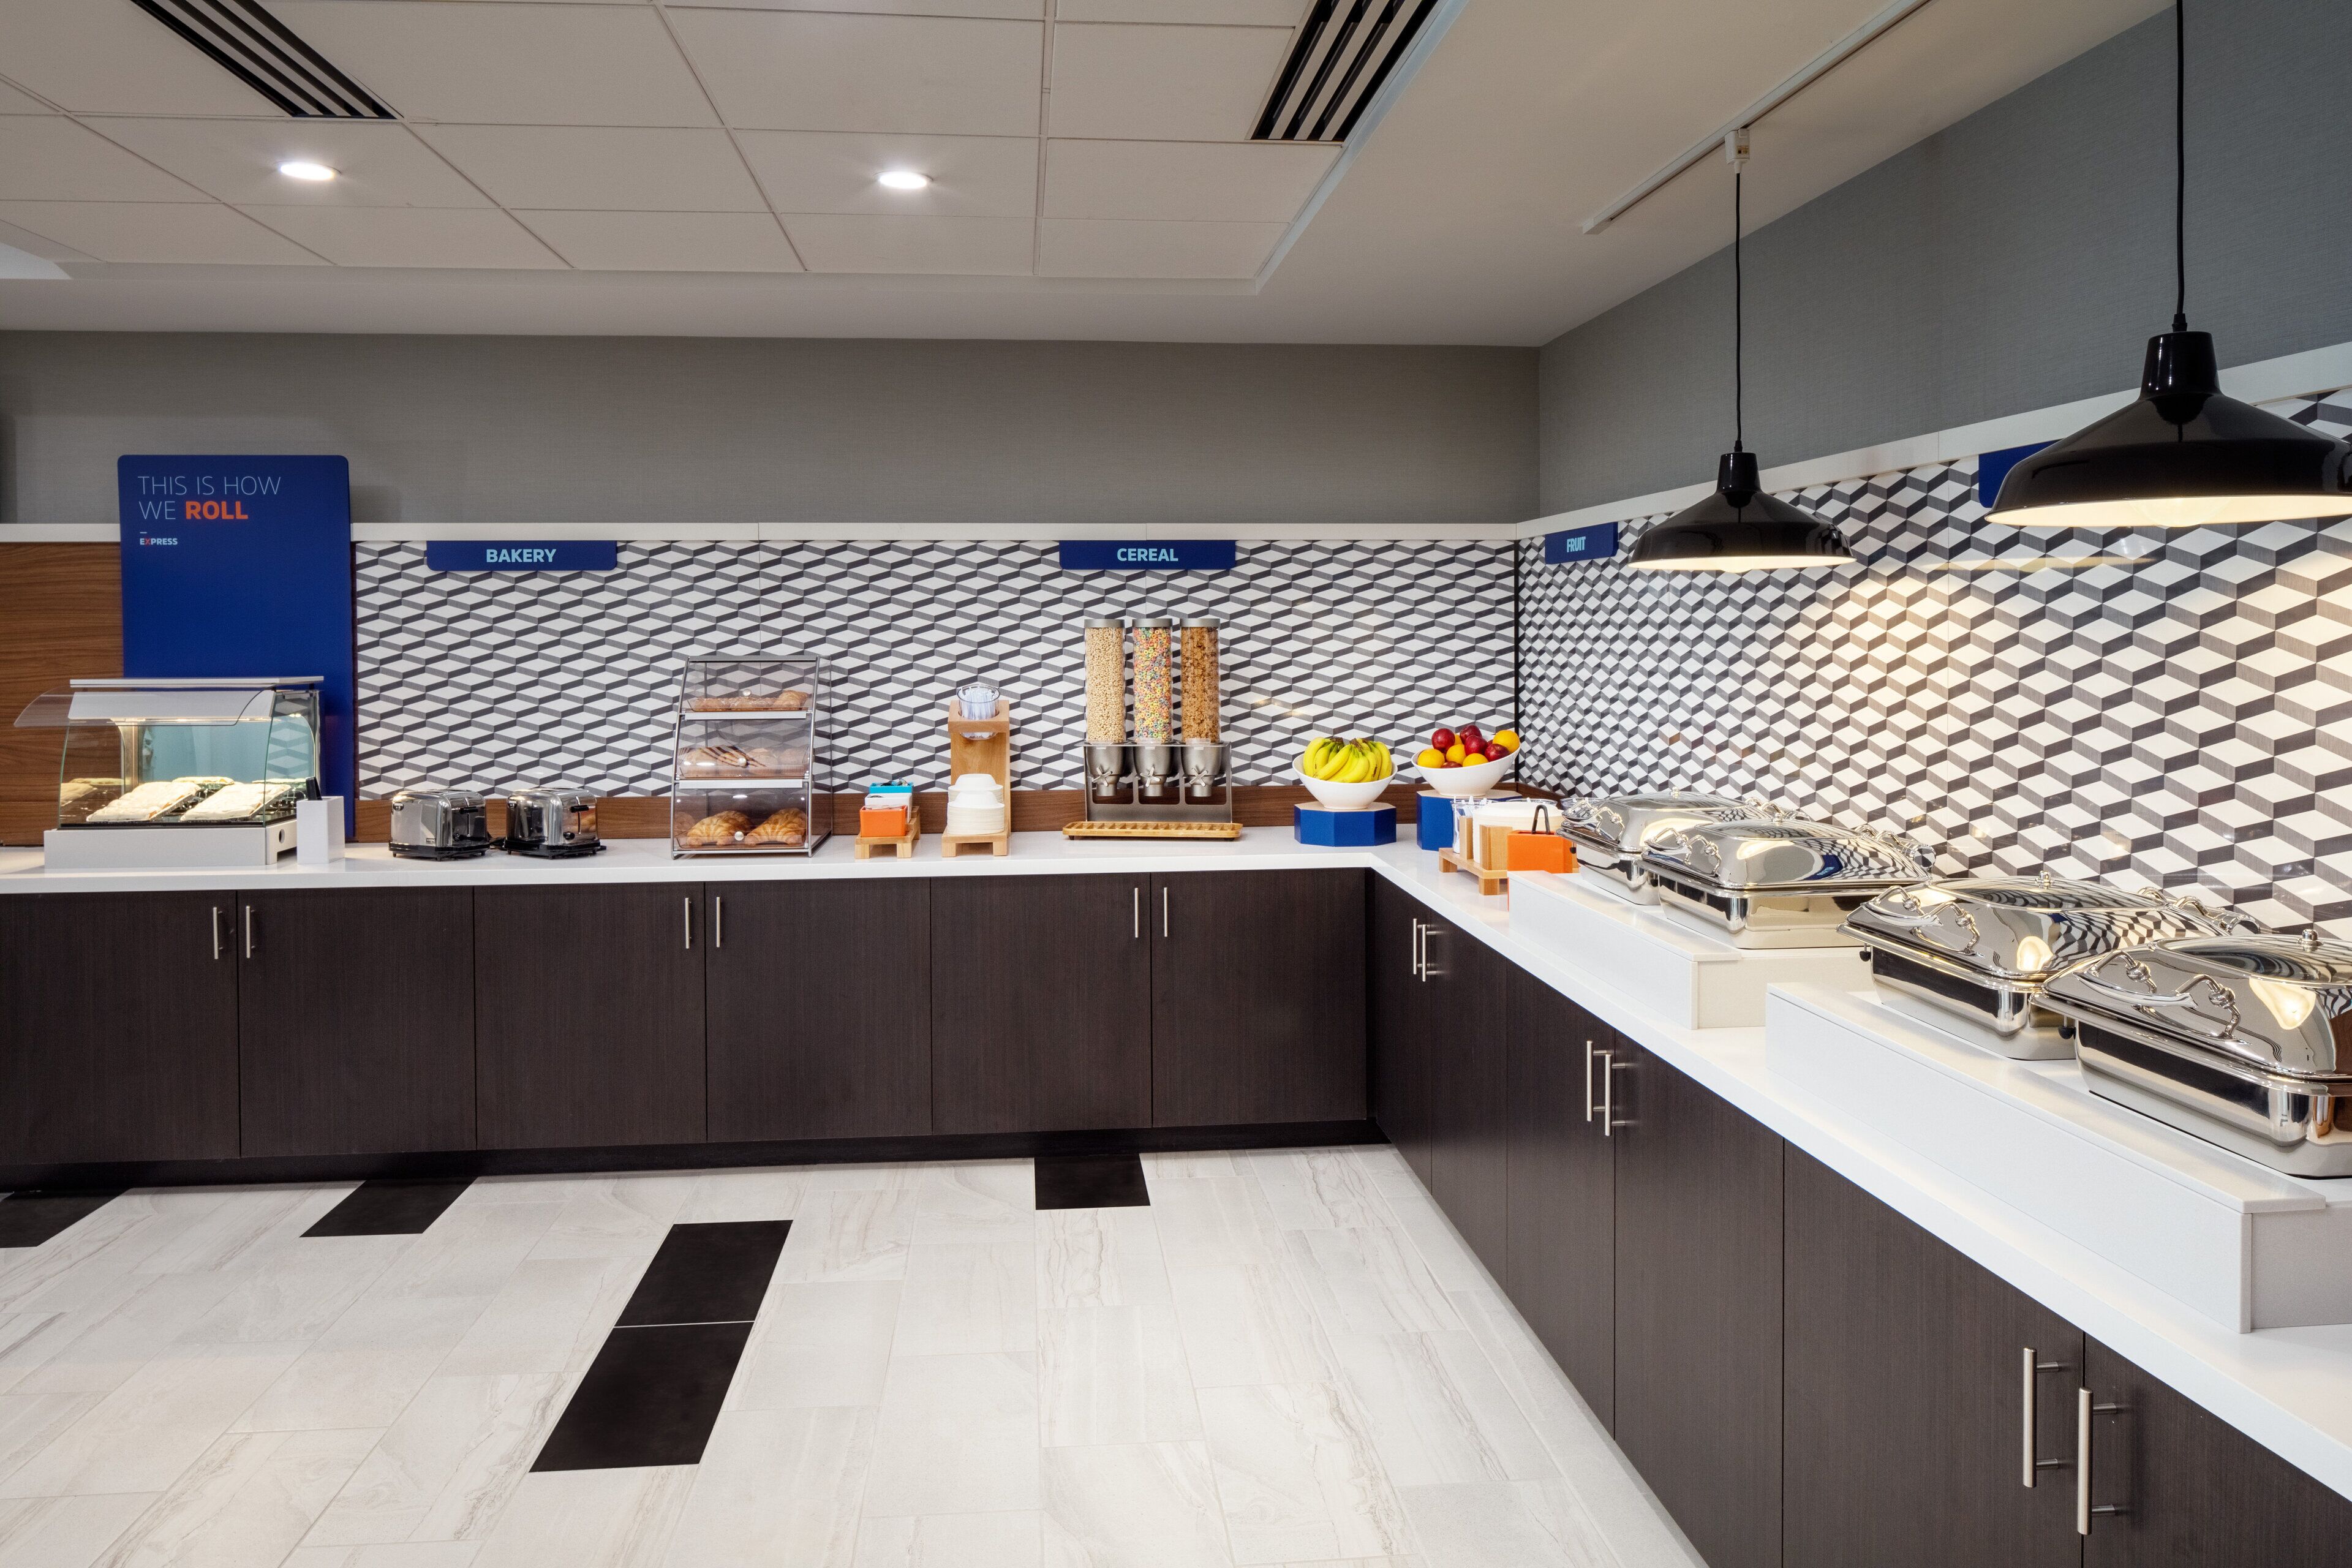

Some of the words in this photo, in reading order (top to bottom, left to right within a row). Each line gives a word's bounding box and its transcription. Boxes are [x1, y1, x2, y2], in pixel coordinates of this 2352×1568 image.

[138, 476, 187, 496] THIS
[197, 476, 214, 496] IS
[224, 476, 281, 496] HOW
[138, 501, 176, 520] WE
[186, 500, 249, 520] ROLL
[1566, 536, 1586, 553] FRUIT
[486, 548, 557, 563] BAKERY
[1117, 548, 1179, 562] CEREAL
